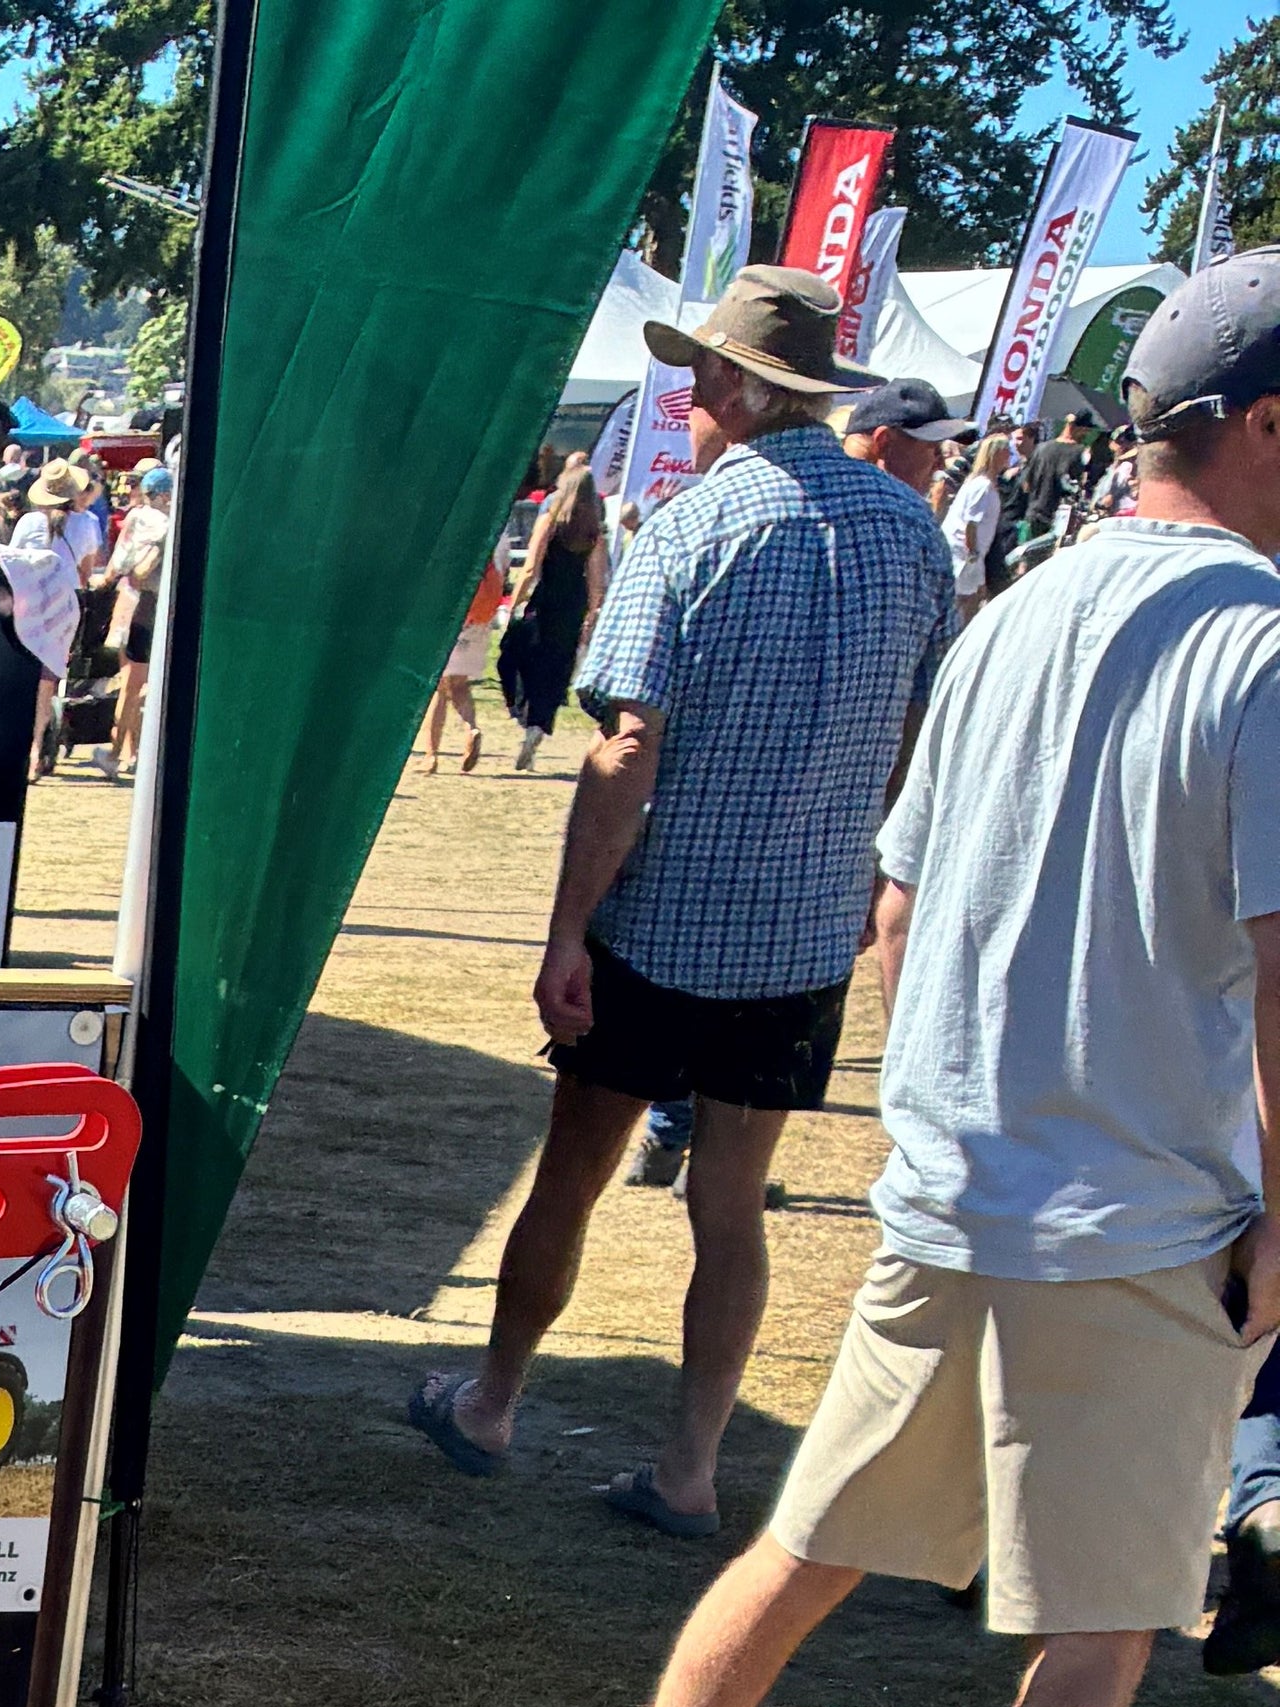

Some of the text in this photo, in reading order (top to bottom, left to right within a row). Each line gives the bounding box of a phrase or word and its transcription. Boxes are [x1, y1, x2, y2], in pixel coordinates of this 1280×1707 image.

[817, 154, 869, 293] NDA
[994, 206, 1078, 414] HONDA
[651, 420, 691, 431] HON
